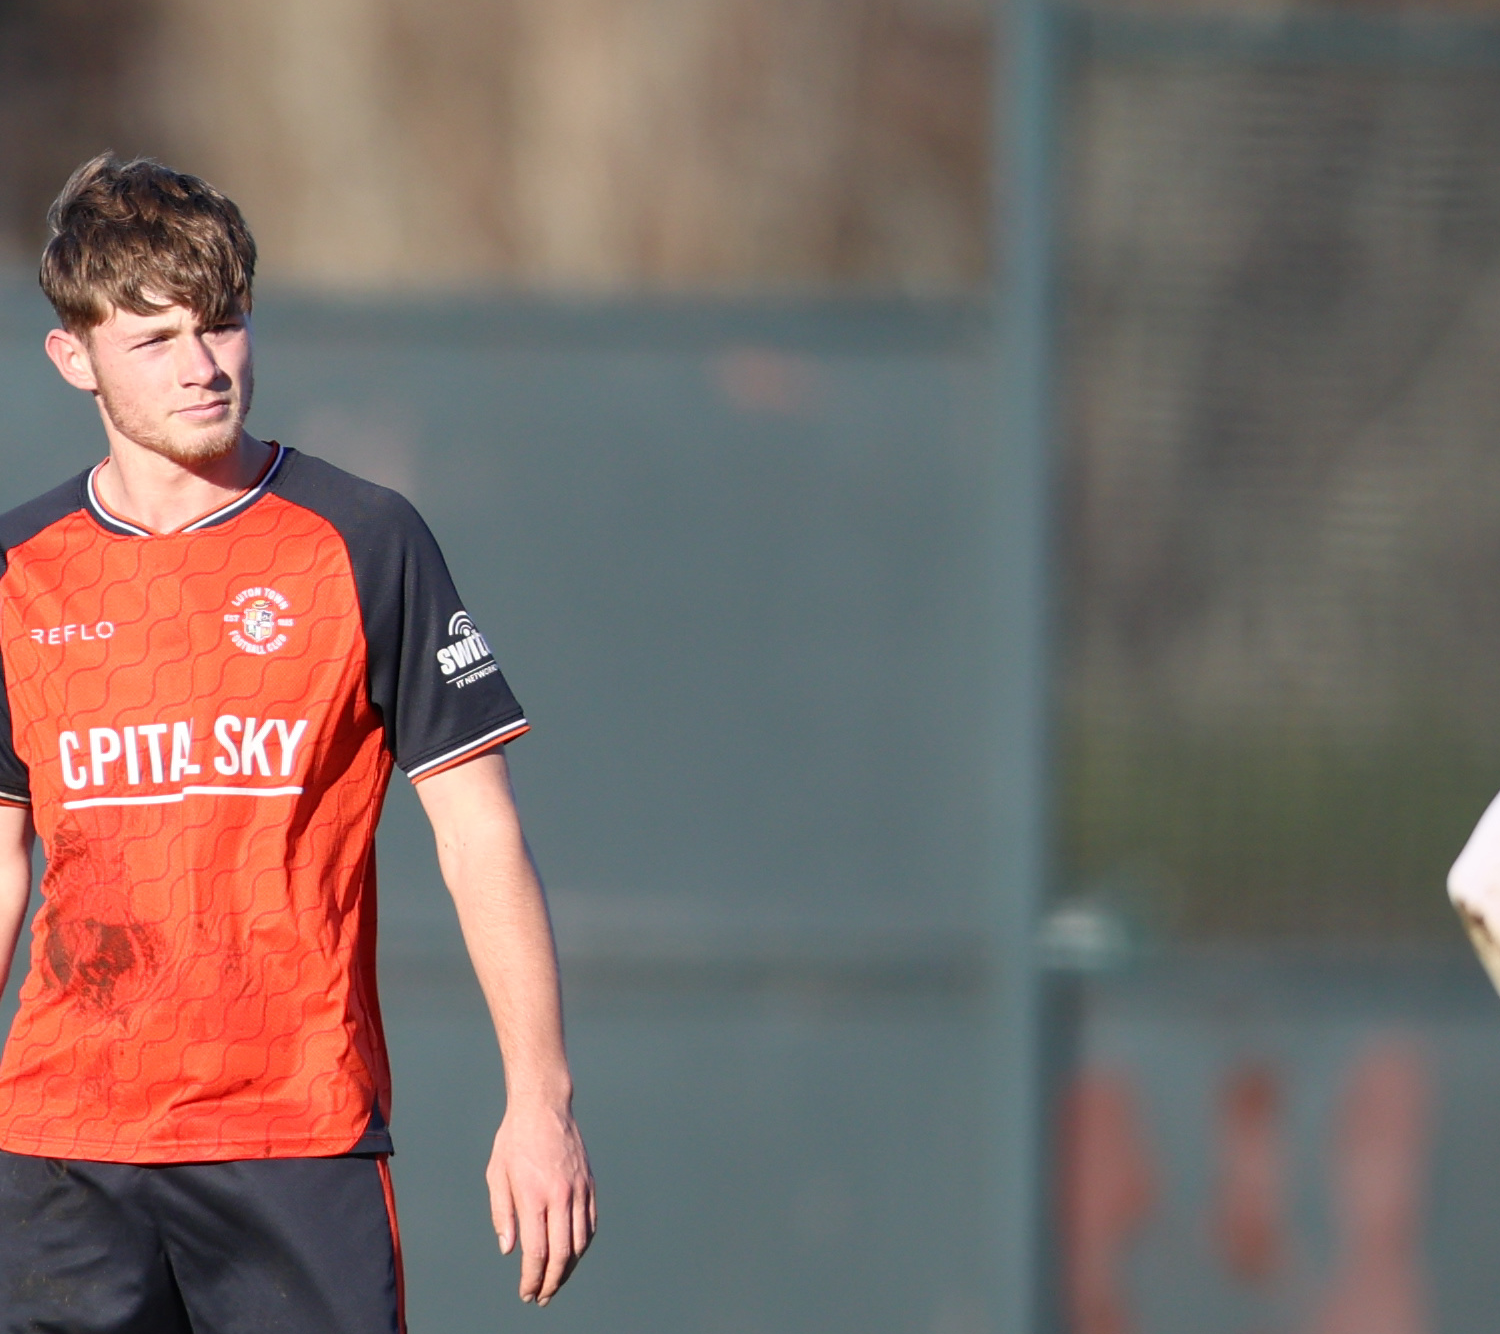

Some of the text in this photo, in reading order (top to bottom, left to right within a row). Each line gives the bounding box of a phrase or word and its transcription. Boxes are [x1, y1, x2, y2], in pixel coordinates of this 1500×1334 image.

[231, 587, 289, 610] LUTON TOWN
[30, 621, 115, 645] REFLO
[213, 714, 309, 777] SKY
